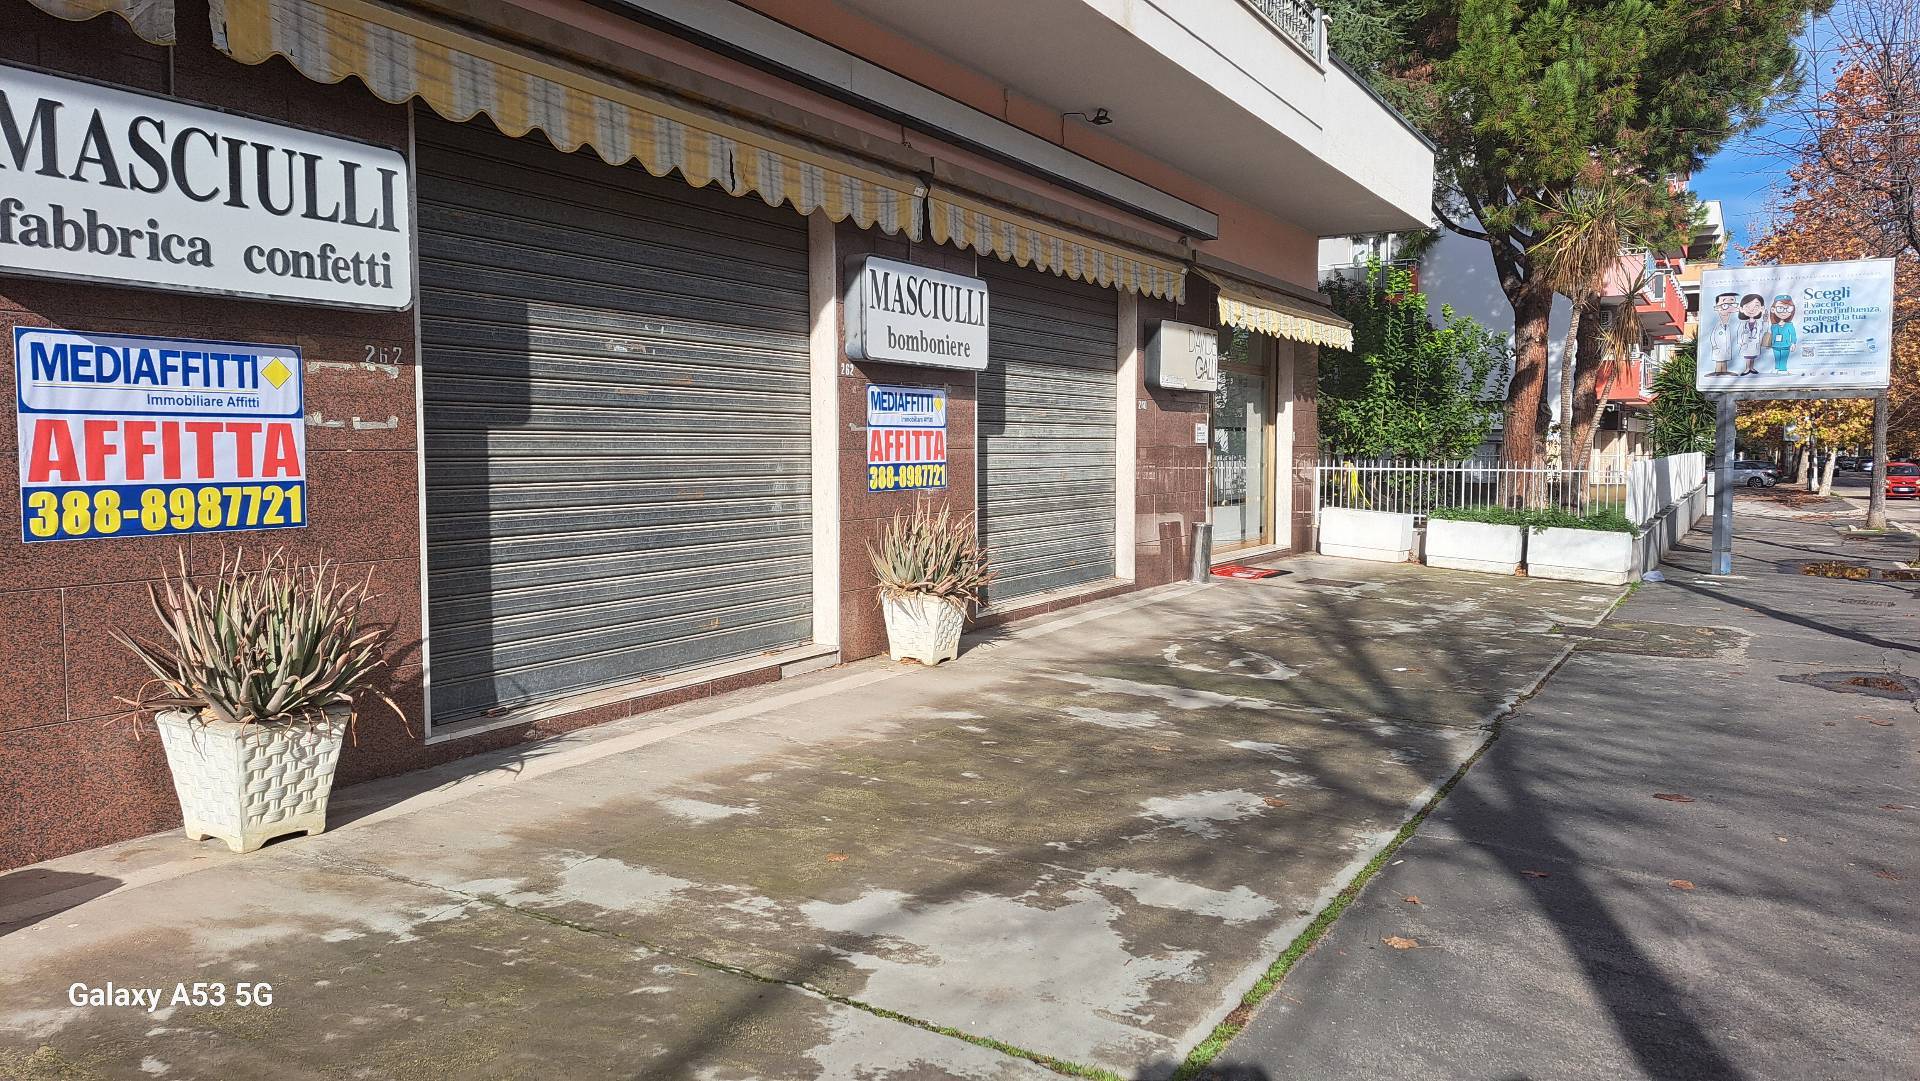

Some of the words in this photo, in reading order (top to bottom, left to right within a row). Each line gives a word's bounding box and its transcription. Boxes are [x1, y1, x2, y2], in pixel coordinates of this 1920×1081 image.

[0, 90, 400, 232] MASCIULLI
[0, 197, 214, 268] fabbrica
[243, 243, 393, 289] confetti
[869, 268, 987, 327] MASCIULLI
[1803, 286, 1851, 302] Scegli
[1802, 322, 1853, 334] salute.
[1803, 314, 1840, 323] proteggi
[365, 344, 403, 366] 262
[887, 325, 971, 358] bomboniere
[30, 342, 259, 389] MEDIAFFITTI
[841, 363, 854, 376] 262
[147, 393, 224, 408] Immobiliare
[227, 395, 260, 408] Affitti
[871, 391, 934, 412] MEDIAFFITTI
[27, 418, 301, 482] AFFITTA
[869, 429, 946, 462] AFFITTA
[869, 464, 946, 489] 388-8987721
[28, 485, 302, 537] 388-8987721
